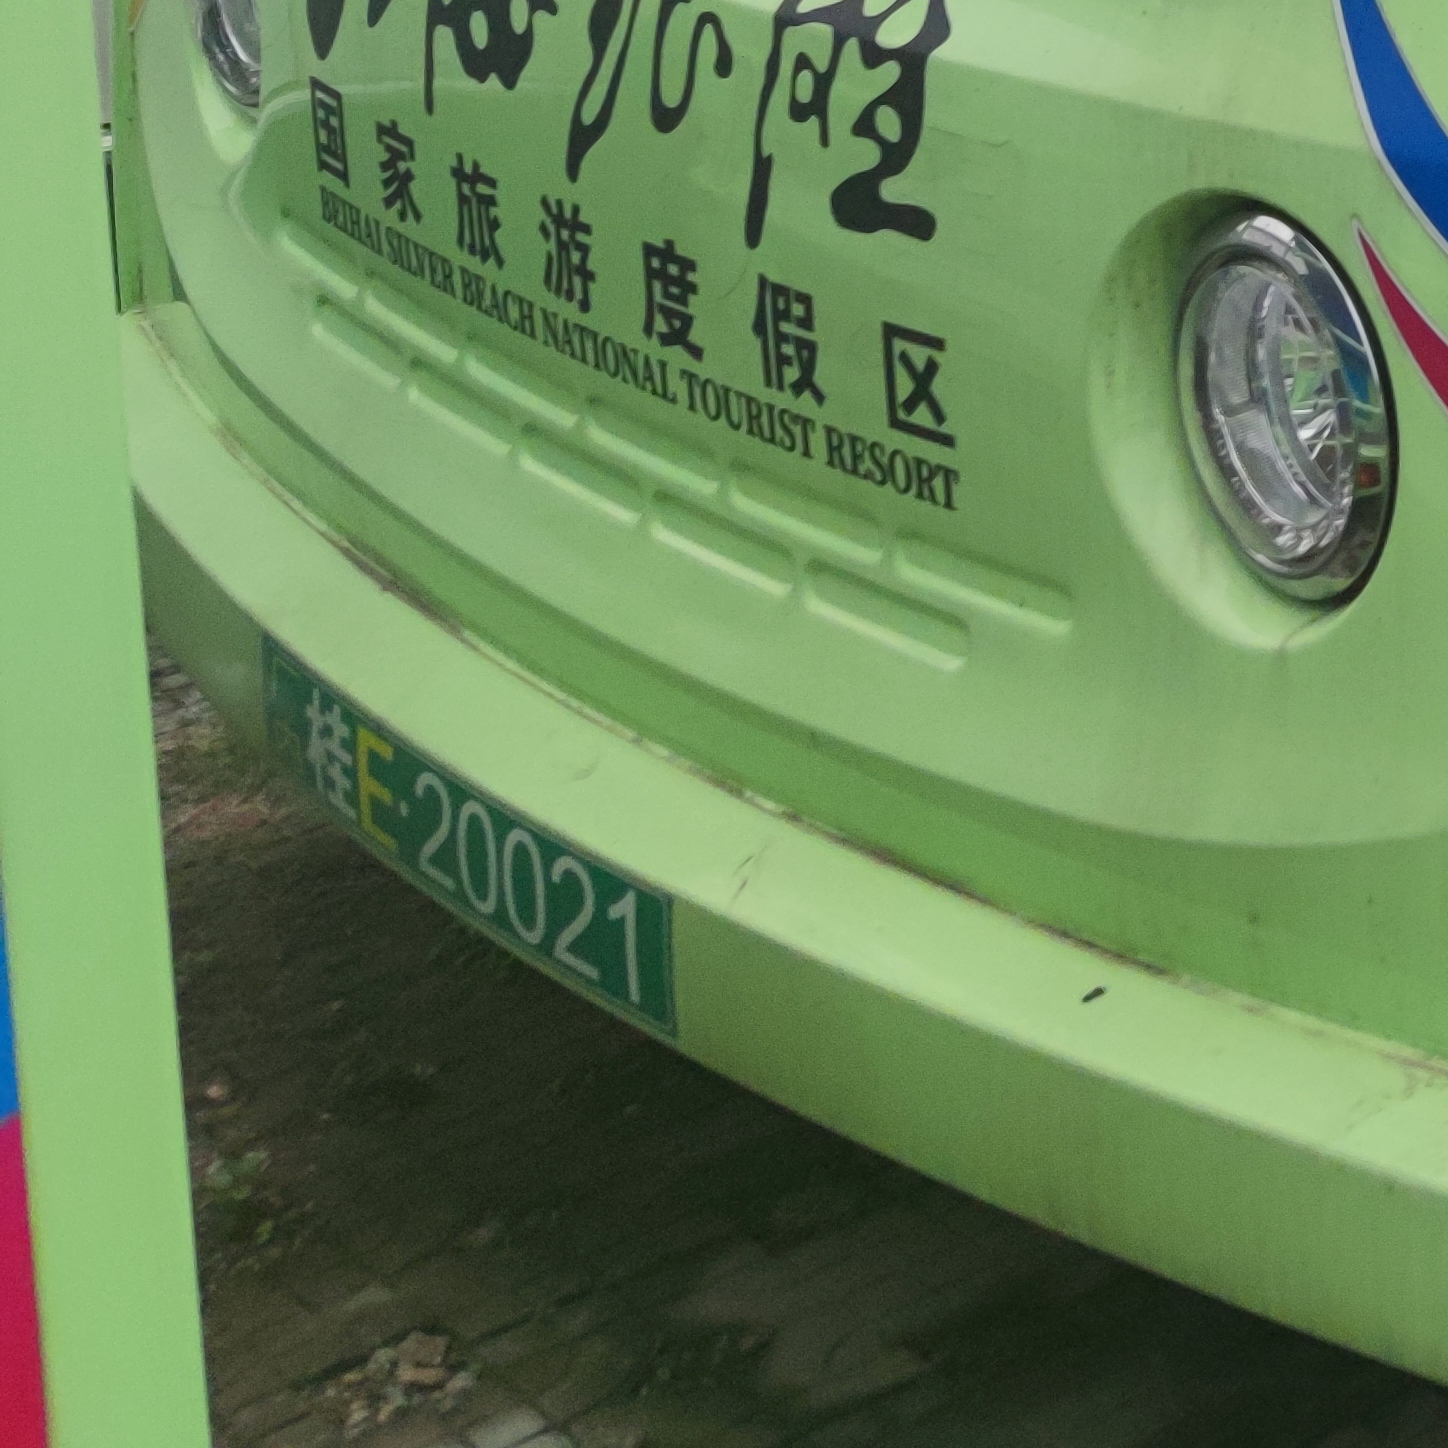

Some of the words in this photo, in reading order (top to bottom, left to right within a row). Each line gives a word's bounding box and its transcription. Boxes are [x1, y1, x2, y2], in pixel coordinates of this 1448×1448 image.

[309, 76, 957, 448] 国家旅游度假区
[319, 184, 384, 255] BEIHAI
[384, 225, 457, 300] SILVER
[457, 265, 537, 341] BEACH
[539, 306, 678, 405] NATIONAL
[679, 367, 816, 460] TOURIST
[823, 423, 960, 511] RESORT
